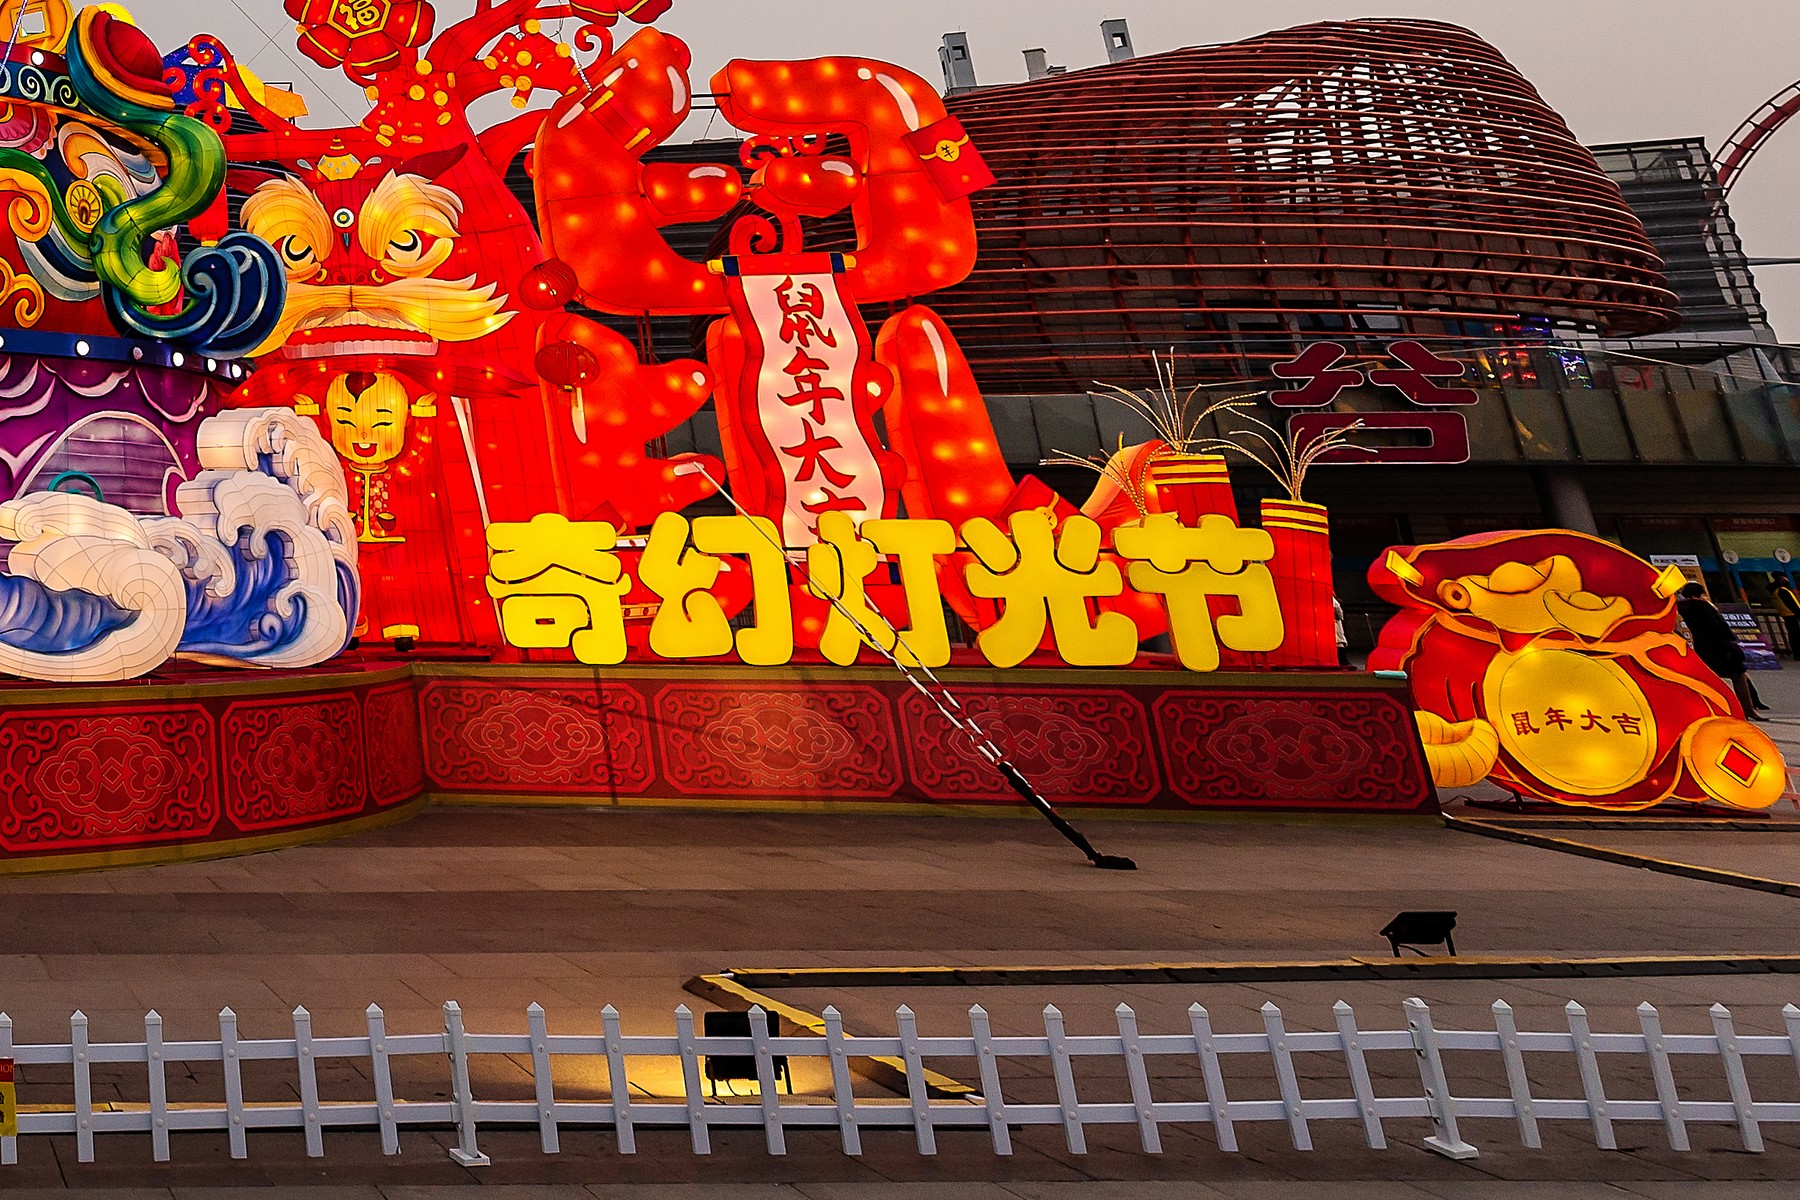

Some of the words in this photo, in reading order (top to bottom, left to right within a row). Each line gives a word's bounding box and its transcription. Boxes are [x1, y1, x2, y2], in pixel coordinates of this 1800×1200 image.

[1270, 341, 1480, 464] 谷
[486, 510, 1285, 673] 奇幻灯光节
[1511, 707, 1642, 736] 鼠年大吉
